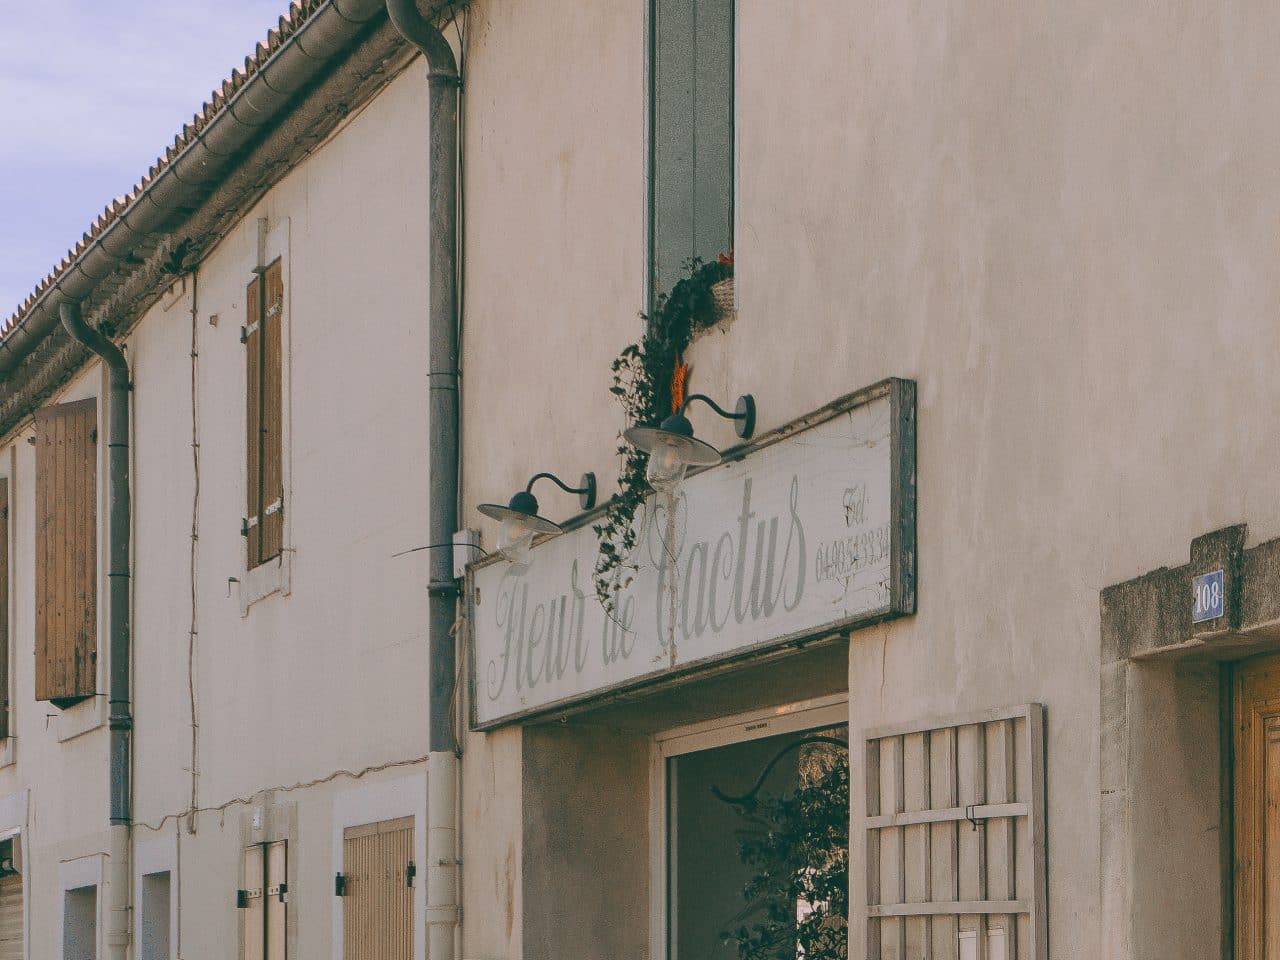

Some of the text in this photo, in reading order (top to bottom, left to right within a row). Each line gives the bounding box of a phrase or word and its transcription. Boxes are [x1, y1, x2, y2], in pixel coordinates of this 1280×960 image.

[487, 558, 592, 701] Fleur
[647, 475, 807, 648] Cactus
[1195, 581, 1219, 613] 108
